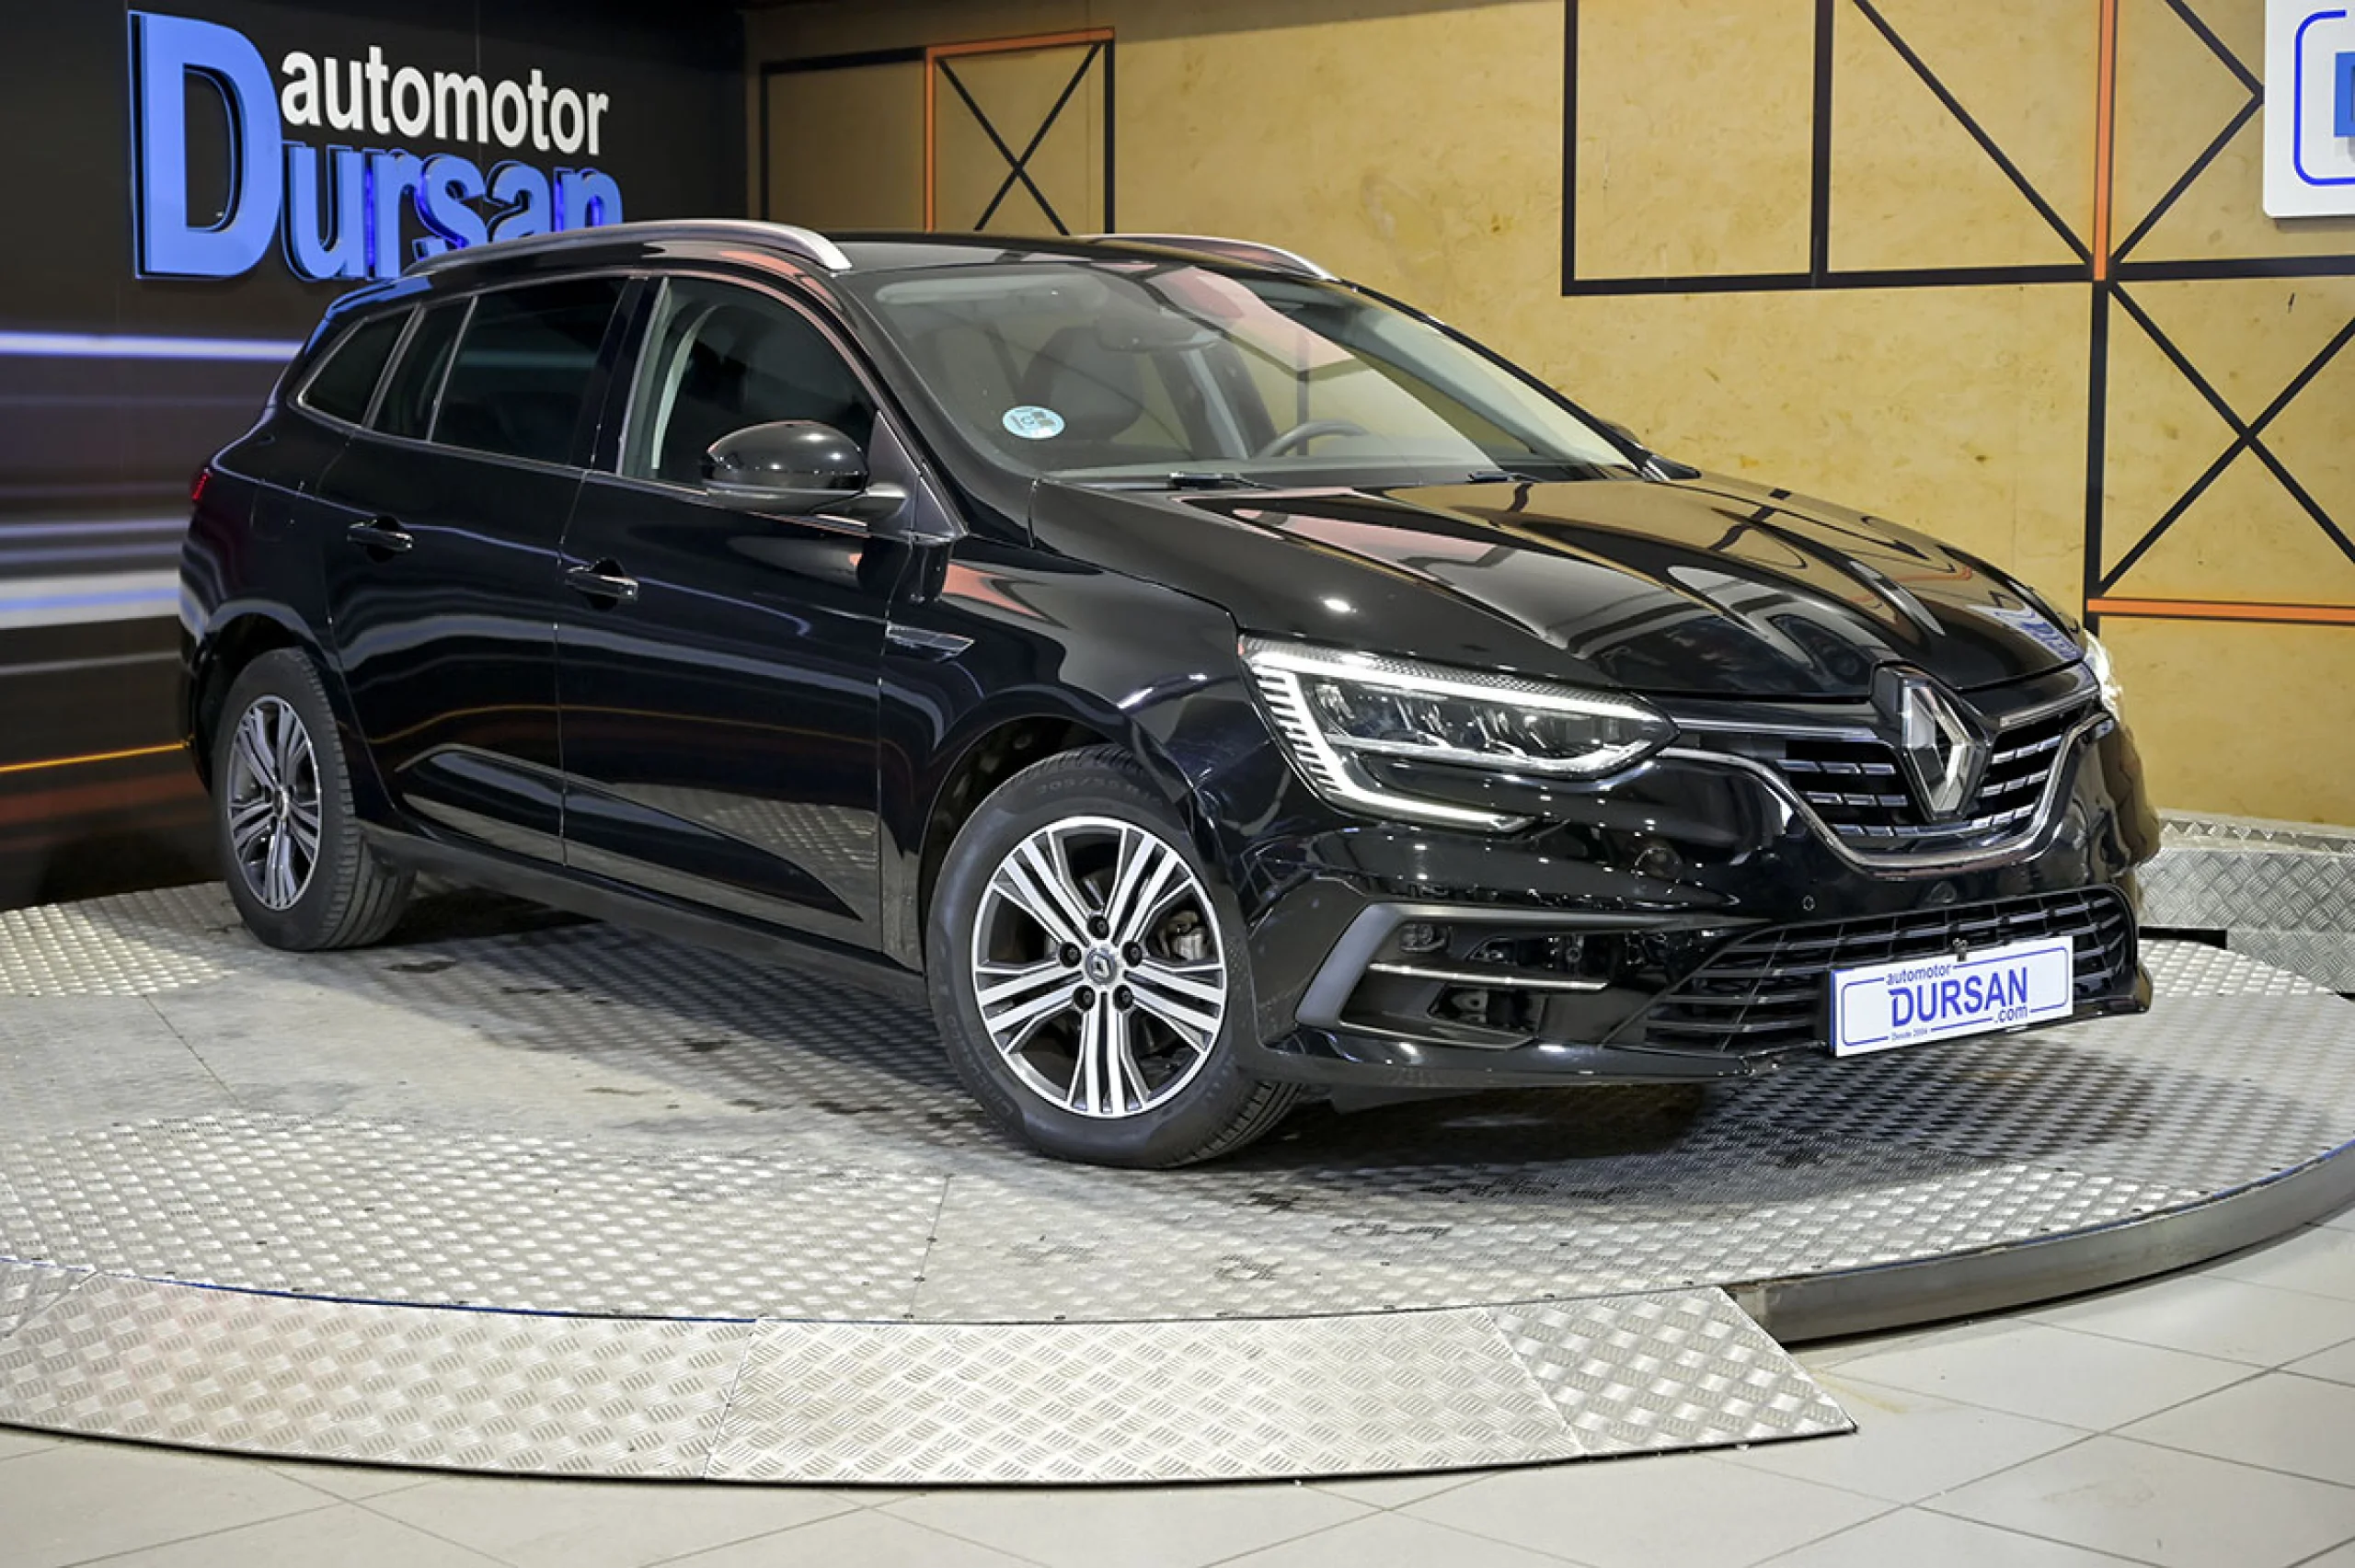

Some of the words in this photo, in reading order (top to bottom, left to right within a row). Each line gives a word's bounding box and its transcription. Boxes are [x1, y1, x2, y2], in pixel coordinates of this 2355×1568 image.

[281, 45, 609, 155] automotor
[1886, 964, 1951, 985] automotor
[1888, 967, 2028, 1027] DURSAN
[1994, 1006, 2028, 1024] .com
